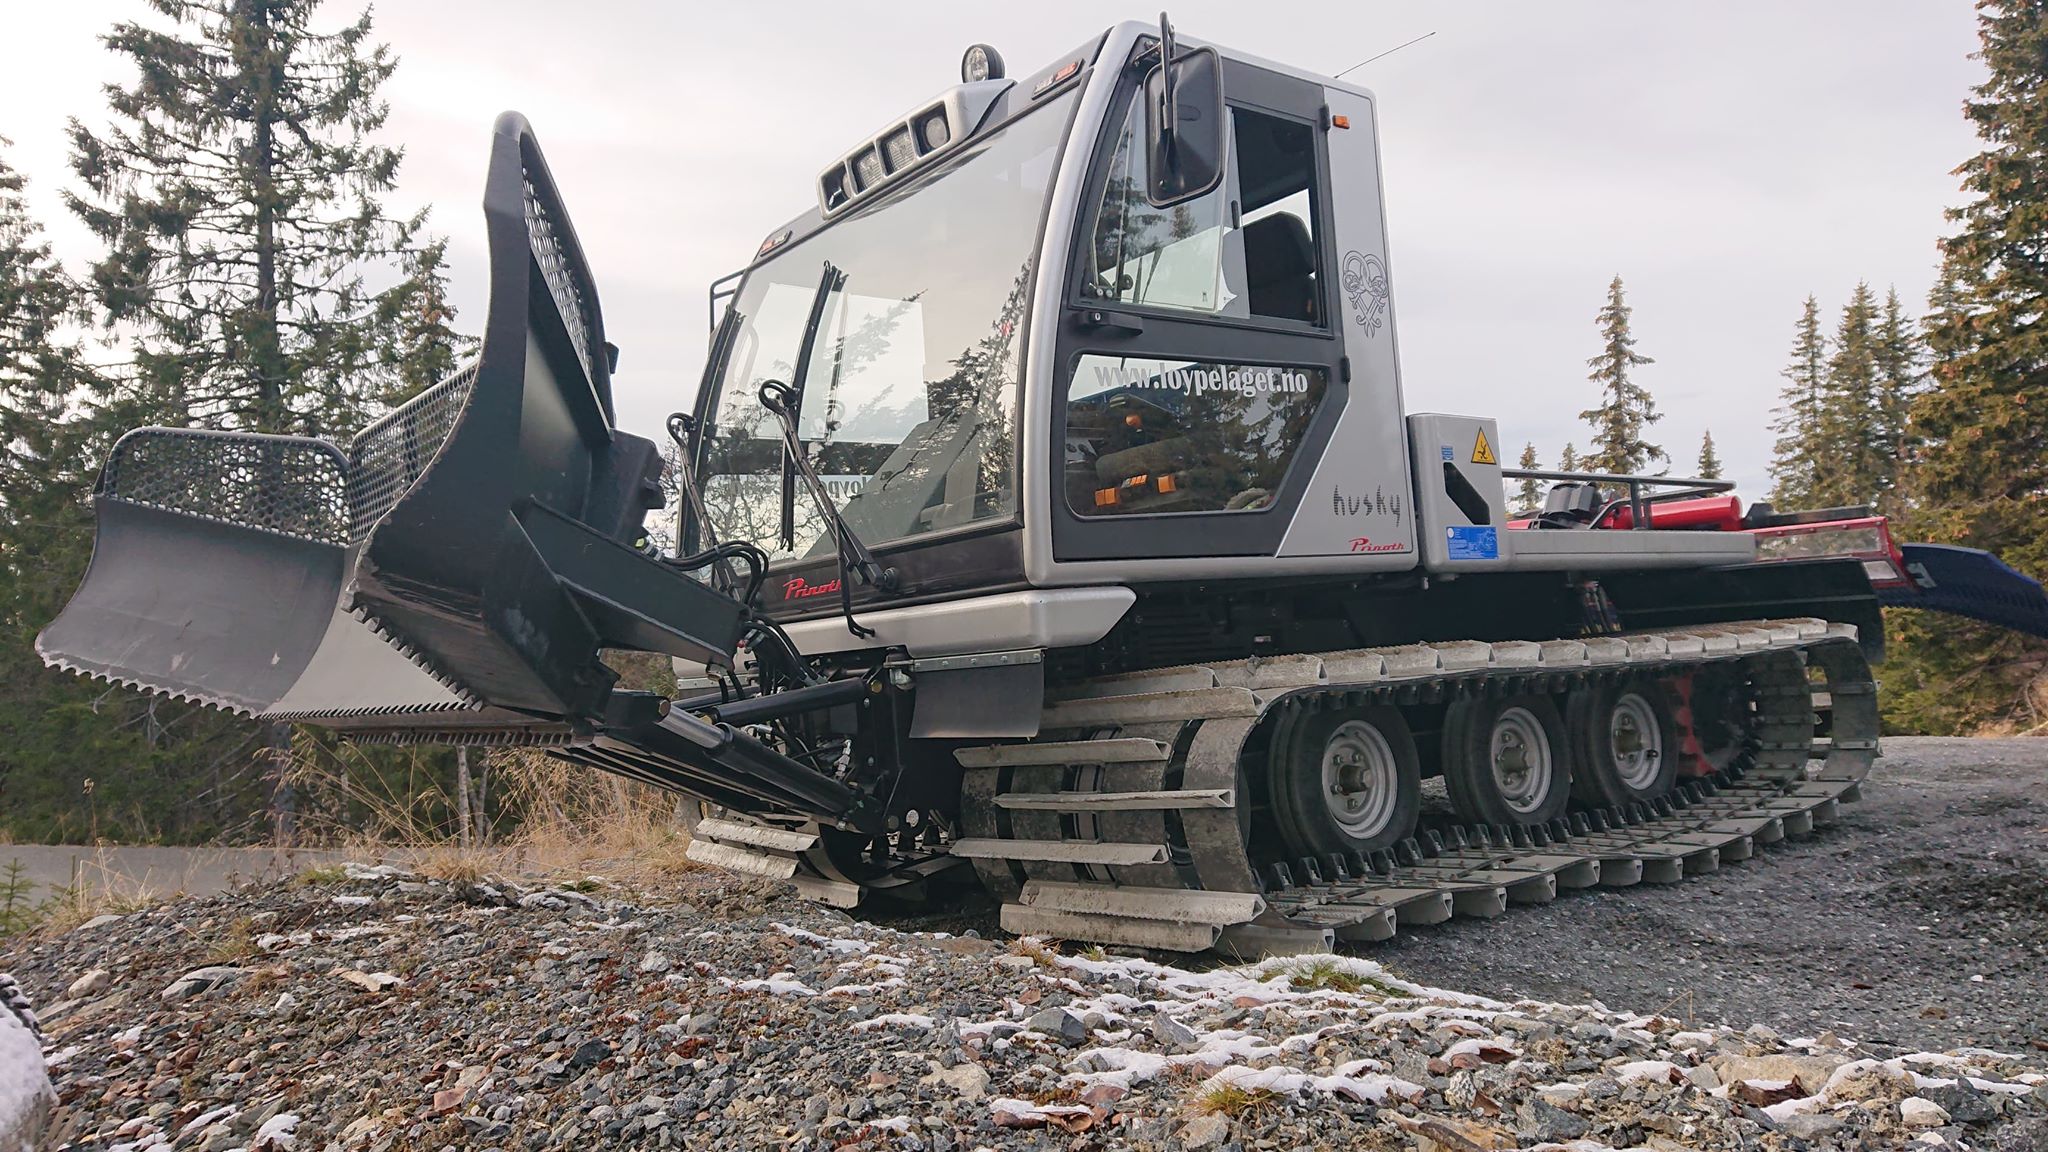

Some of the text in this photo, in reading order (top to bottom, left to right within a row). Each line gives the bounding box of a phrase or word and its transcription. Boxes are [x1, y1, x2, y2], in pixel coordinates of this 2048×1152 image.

[1094, 362, 1308, 397] www.loypelaget.no
[1333, 484, 1401, 528] husky
[1348, 537, 1405, 552] Prinoth
